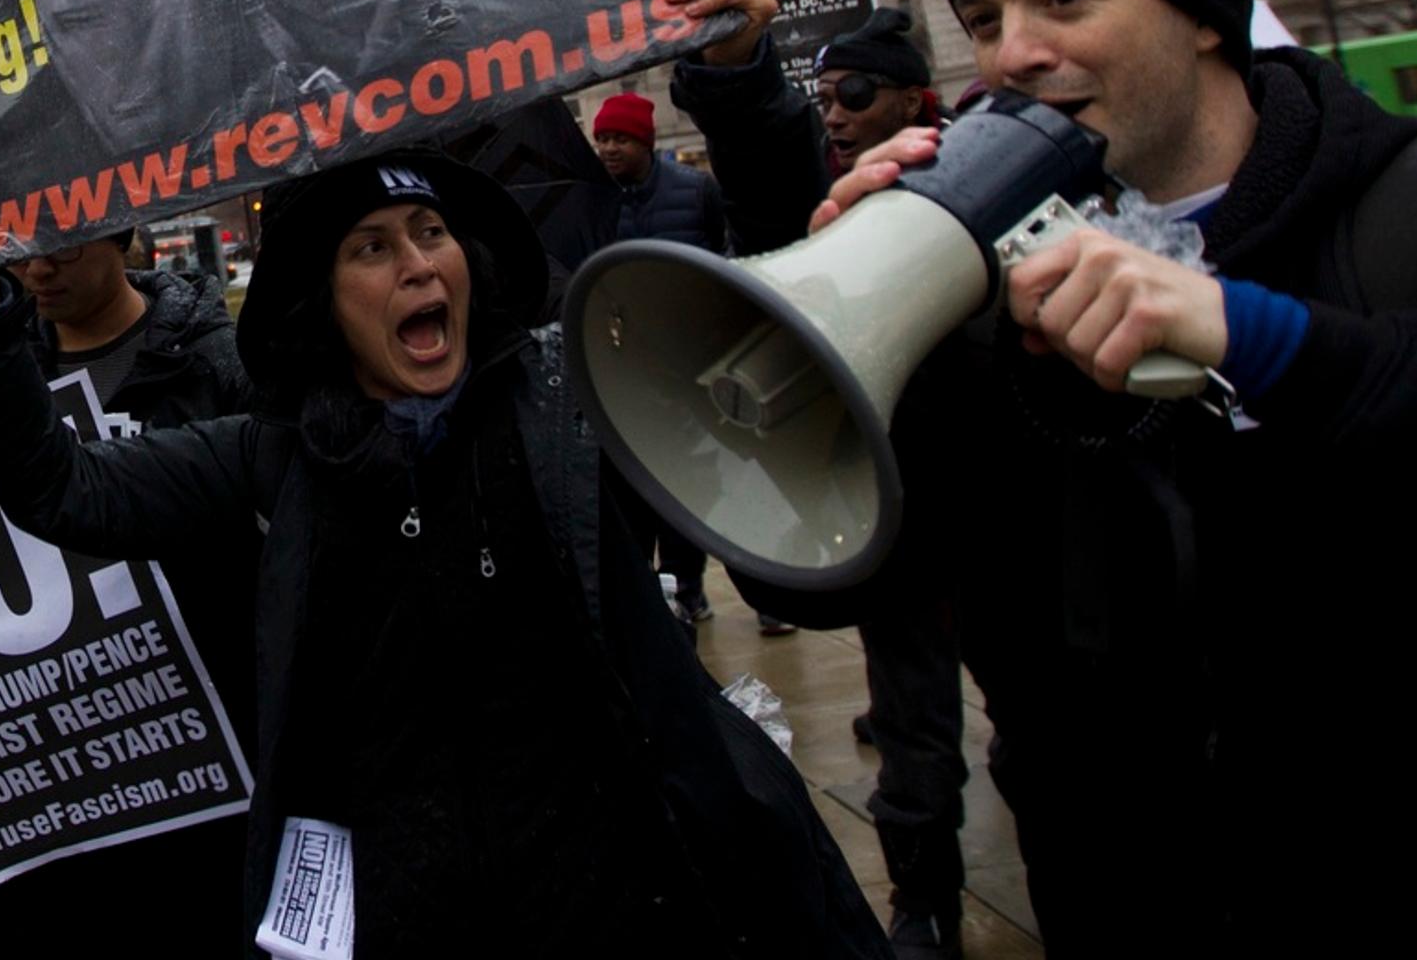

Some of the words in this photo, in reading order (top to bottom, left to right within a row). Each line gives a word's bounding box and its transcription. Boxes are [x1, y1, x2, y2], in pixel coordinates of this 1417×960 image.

[48, 663, 189, 737] REGIME
[50, 748, 85, 783] IT
[83, 707, 209, 771] STARTS
[300, 833, 327, 869] NO!
